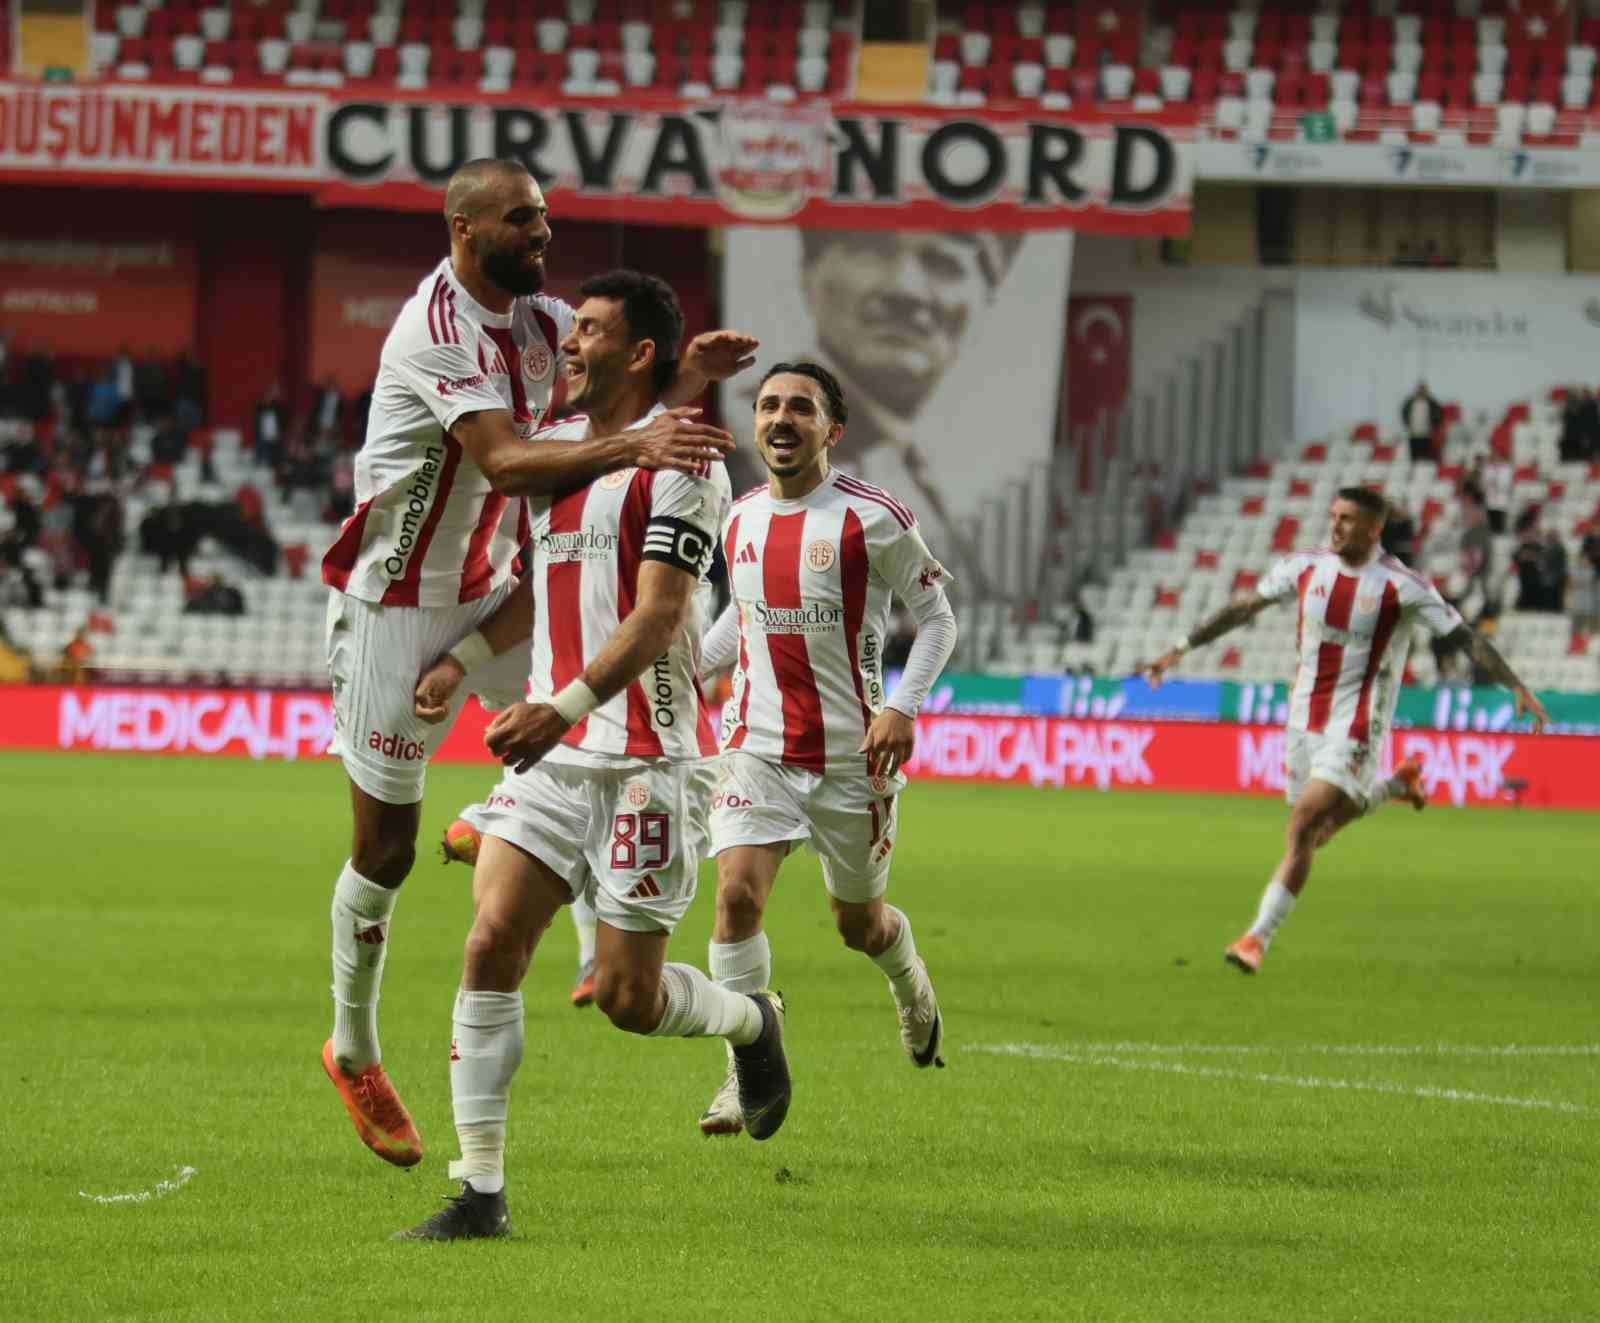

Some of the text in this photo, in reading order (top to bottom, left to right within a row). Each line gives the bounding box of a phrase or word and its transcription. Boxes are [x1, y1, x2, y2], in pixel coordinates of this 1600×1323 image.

[328, 103, 1175, 204] CURVA NORD
[541, 525, 617, 552] Swandor
[755, 600, 844, 624] Swandor
[611, 812, 670, 868] 89
